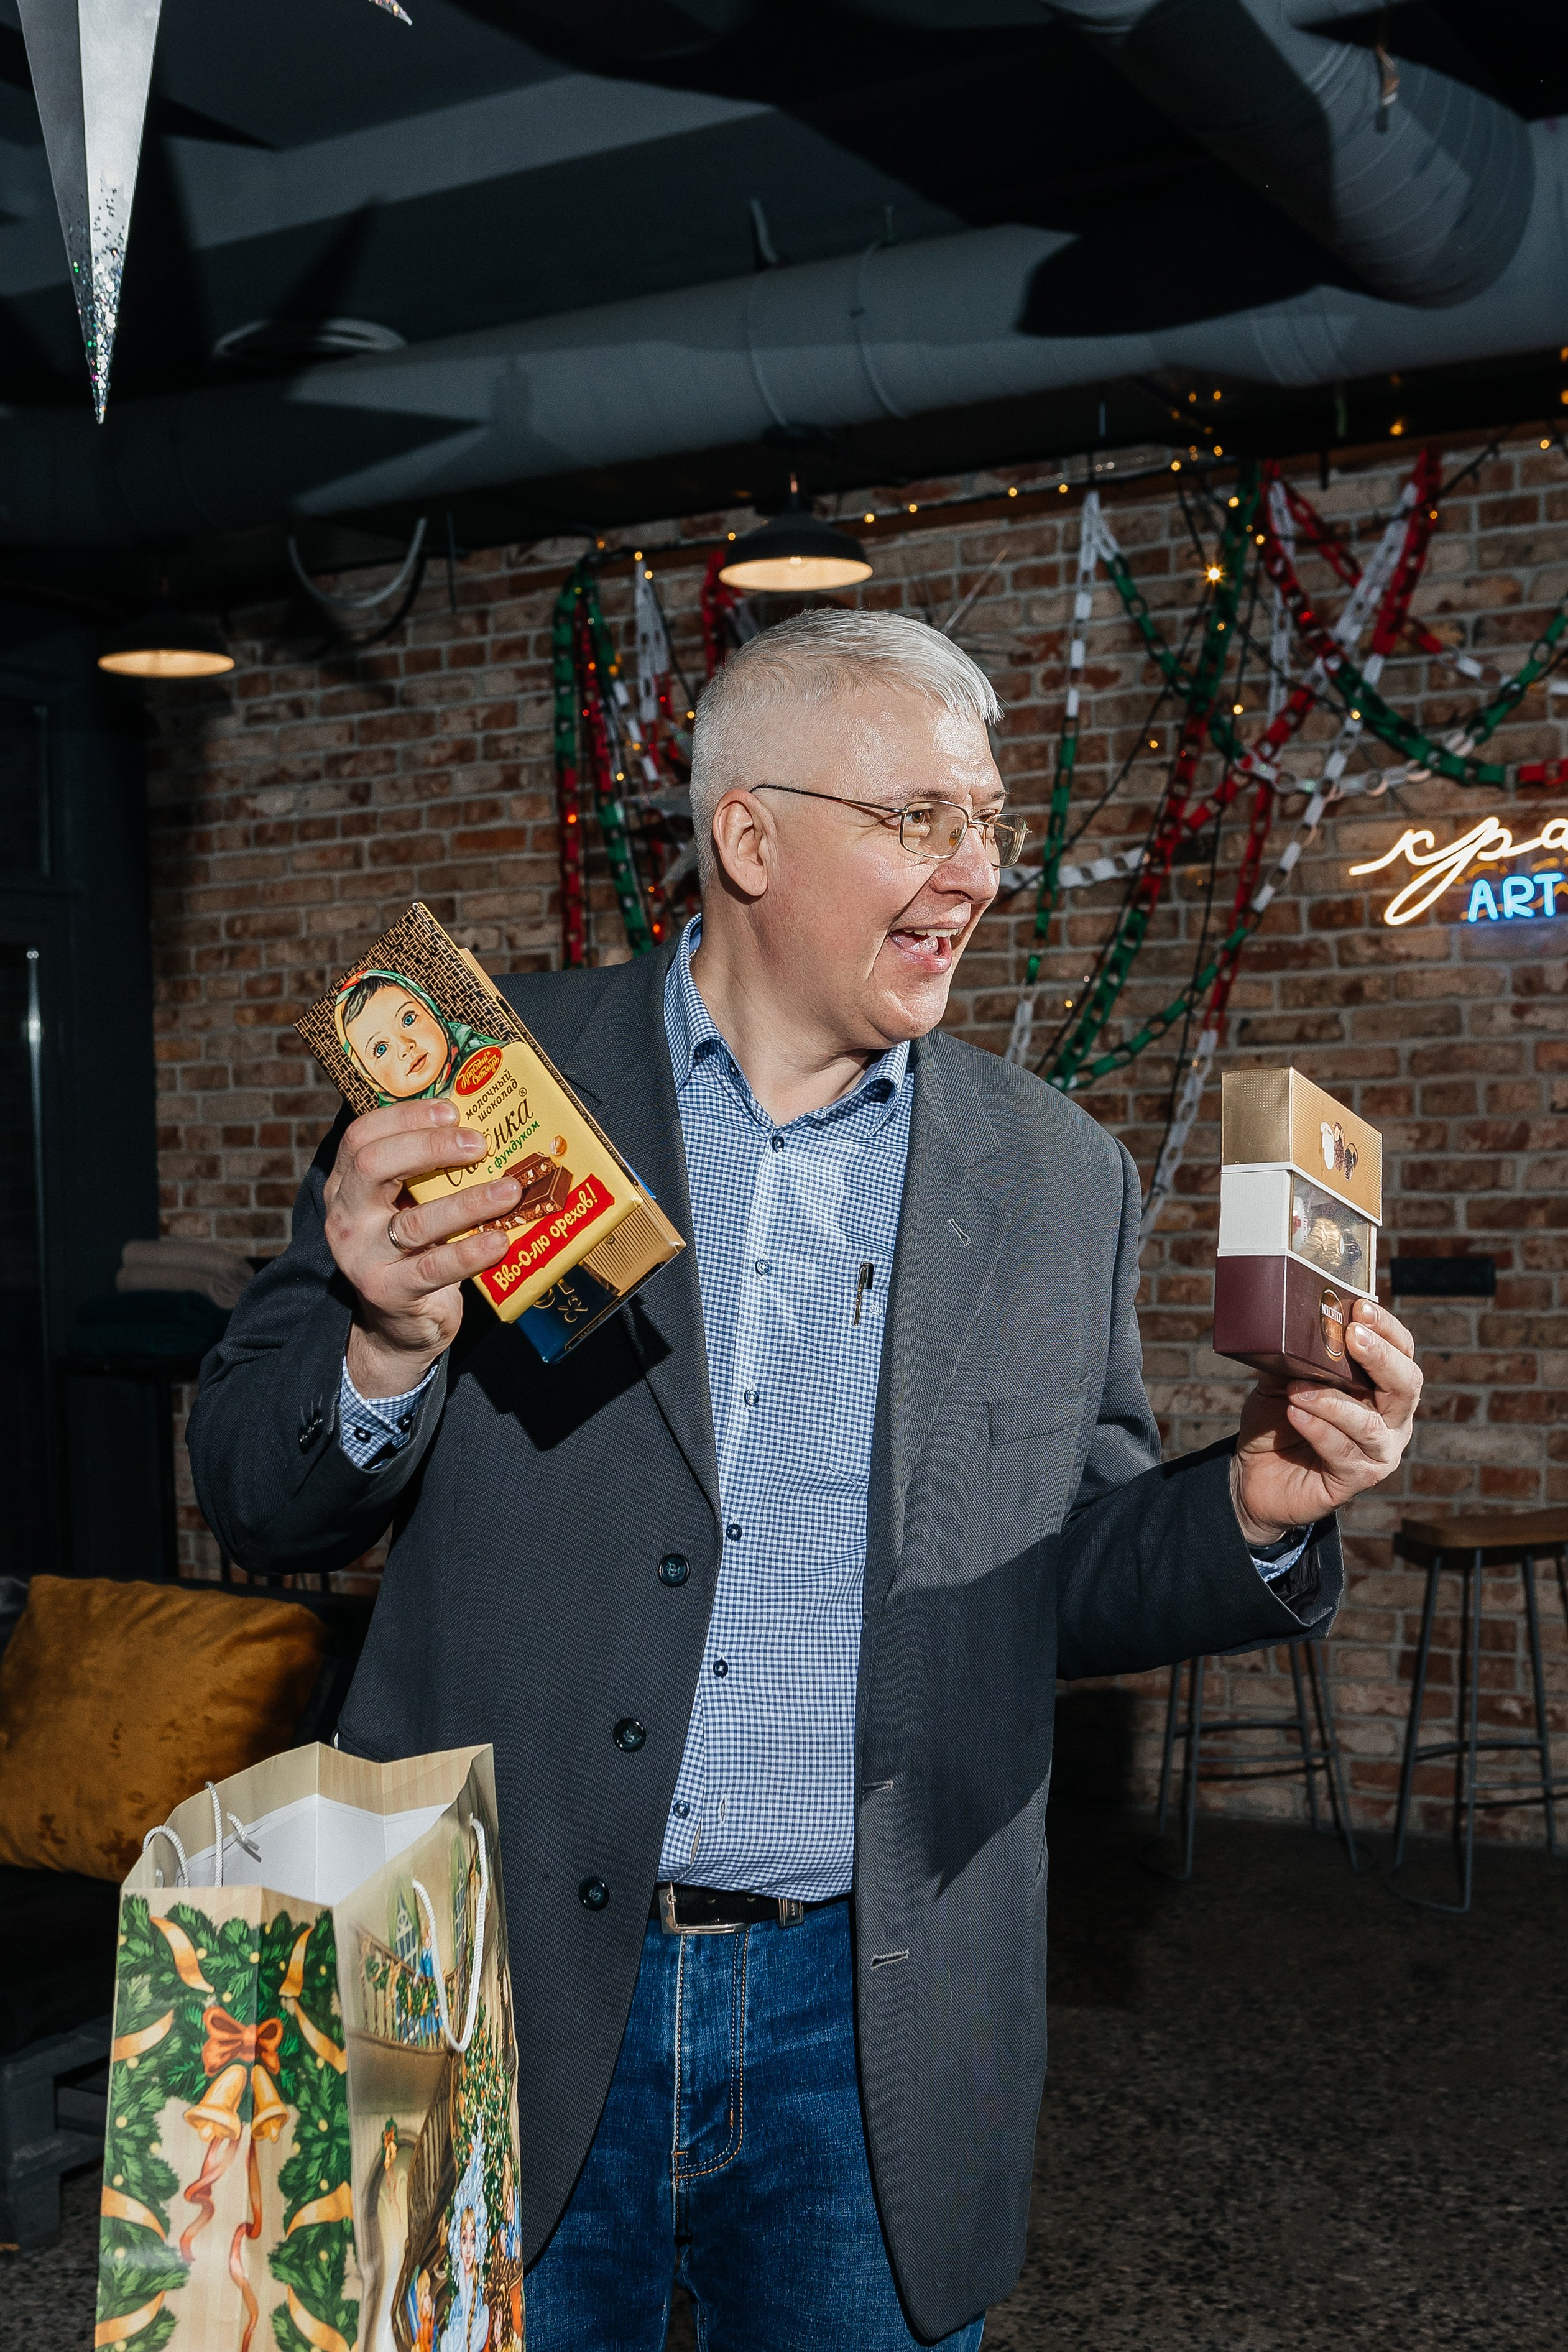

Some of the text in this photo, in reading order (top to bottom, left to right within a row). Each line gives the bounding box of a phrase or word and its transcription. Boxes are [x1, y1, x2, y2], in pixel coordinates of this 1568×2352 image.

[1467, 872, 1564, 923] ART
[507, 1010, 526, 1034] КАКАО
[458, 1051, 491, 1090] Красный
[473, 1054, 499, 1085] Октябрь
[465, 1069, 512, 1120] молочный
[477, 1078, 517, 1122] шоколад
[487, 1121, 540, 1174] с фундуком
[492, 1183, 598, 1292] Вво-О-лю орехов!
